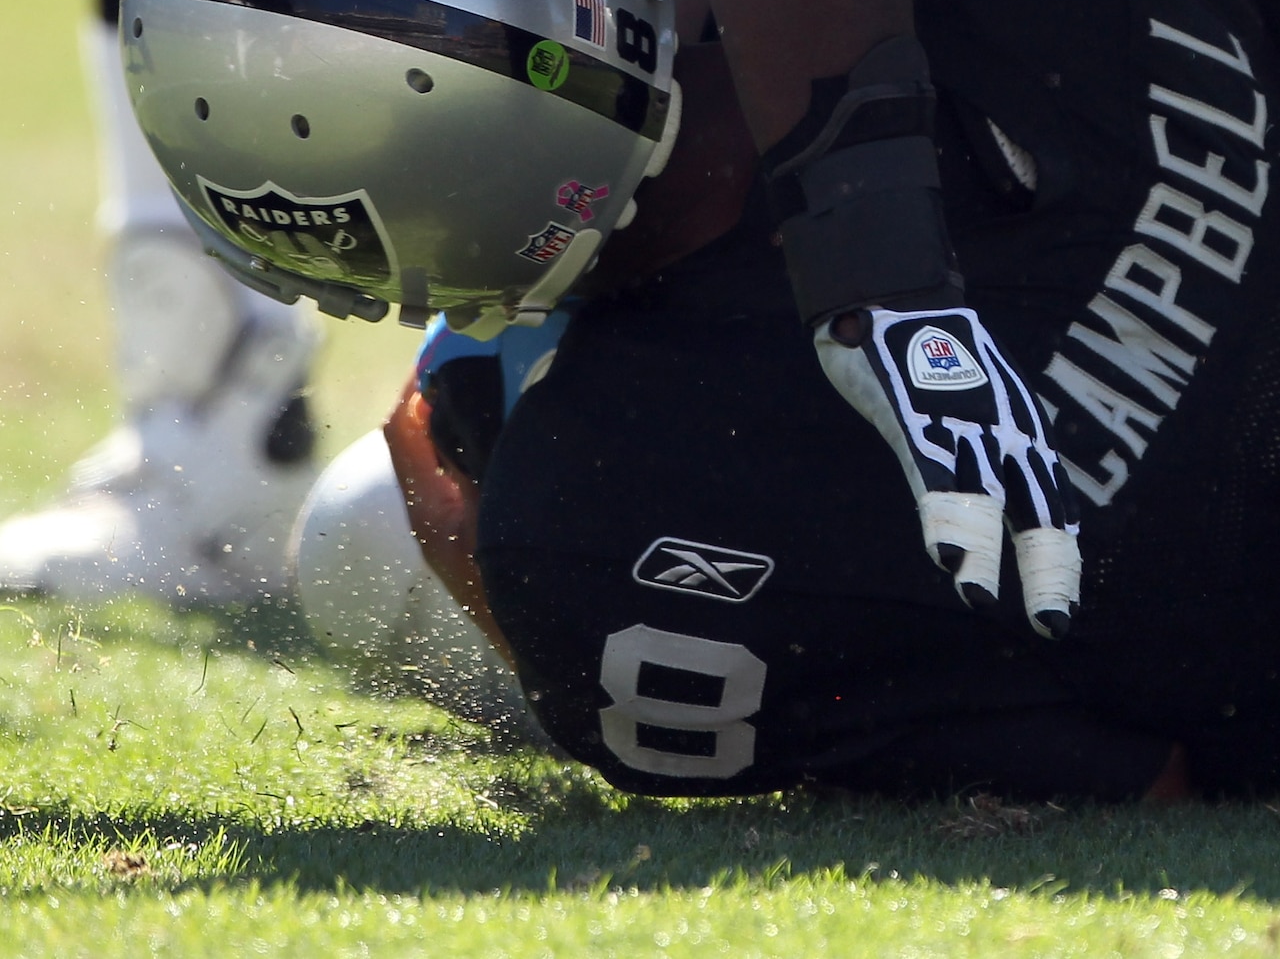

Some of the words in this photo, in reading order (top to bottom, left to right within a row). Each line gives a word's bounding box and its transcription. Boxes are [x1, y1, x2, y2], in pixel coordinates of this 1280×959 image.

[616, 7, 657, 75] 8
[220, 197, 351, 226] RAIDERS
[533, 232, 573, 261] NFL
[1037, 18, 1270, 507] CAMPBELL
[922, 339, 954, 358] NFL
[921, 368, 977, 381] EQUIPMENT
[599, 621, 767, 780] 8
